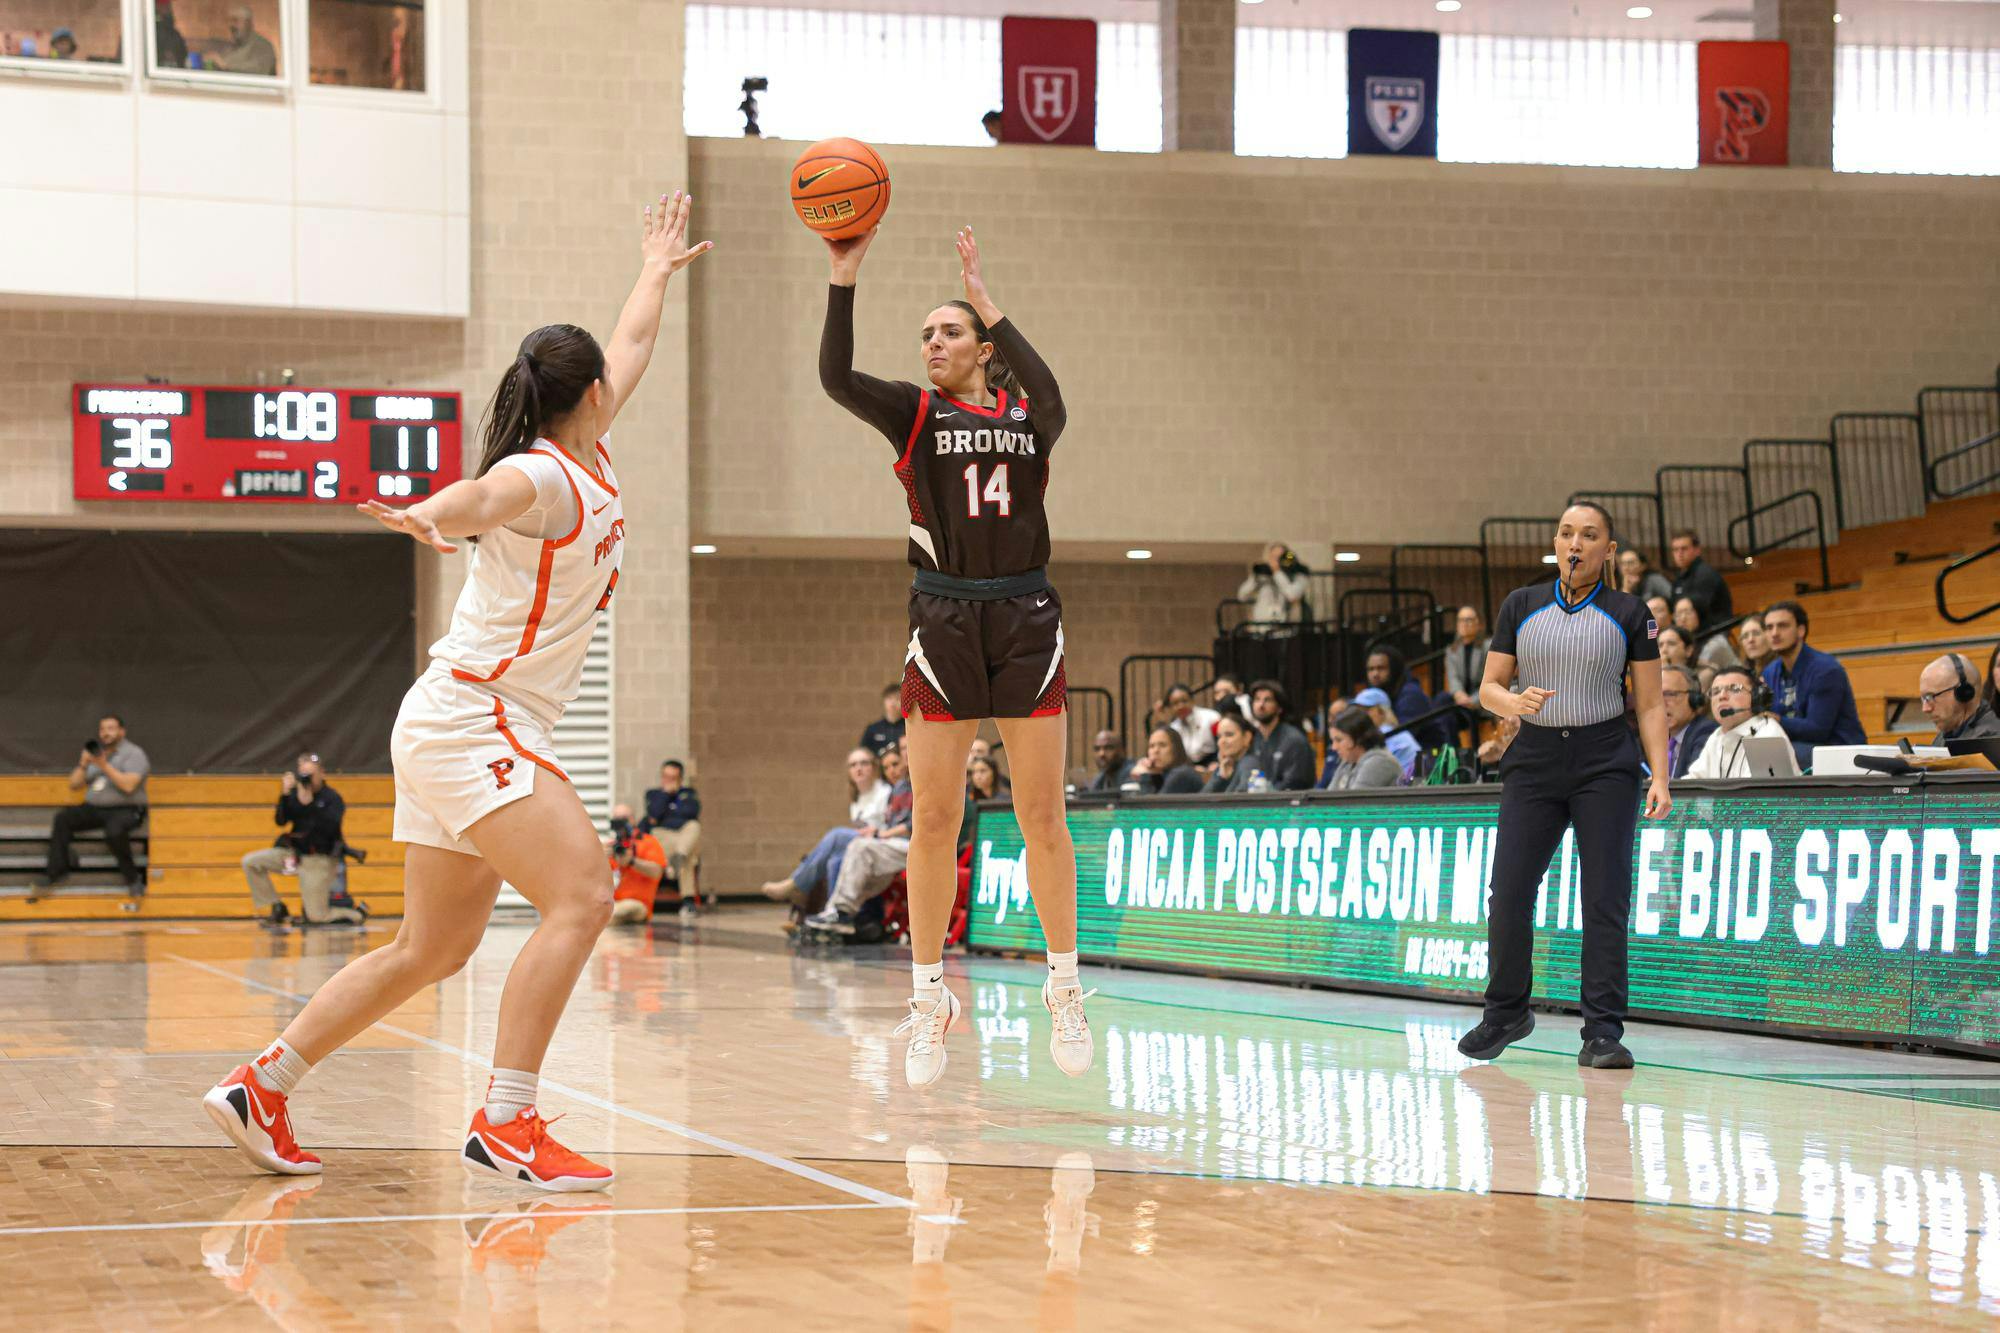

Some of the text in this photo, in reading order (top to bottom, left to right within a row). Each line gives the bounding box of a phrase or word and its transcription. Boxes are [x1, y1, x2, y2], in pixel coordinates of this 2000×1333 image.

[1033, 76, 1064, 118] H
[1386, 104, 1408, 133] P
[801, 199, 854, 220] ELITE
[254, 391, 337, 441] 1:08
[112, 418, 172, 469] 36
[397, 426, 438, 471] 11
[934, 429, 1036, 456] BROWN
[241, 461, 338, 498] period 2
[963, 462, 1012, 518] 14
[487, 757, 514, 790] P
[1105, 828, 1125, 905] 8
[1127, 828, 1205, 911] NCAA
[1213, 827, 1443, 923] POSTSEASON
[1678, 828, 1773, 942] BID
[1793, 828, 2000, 957] SPORT
